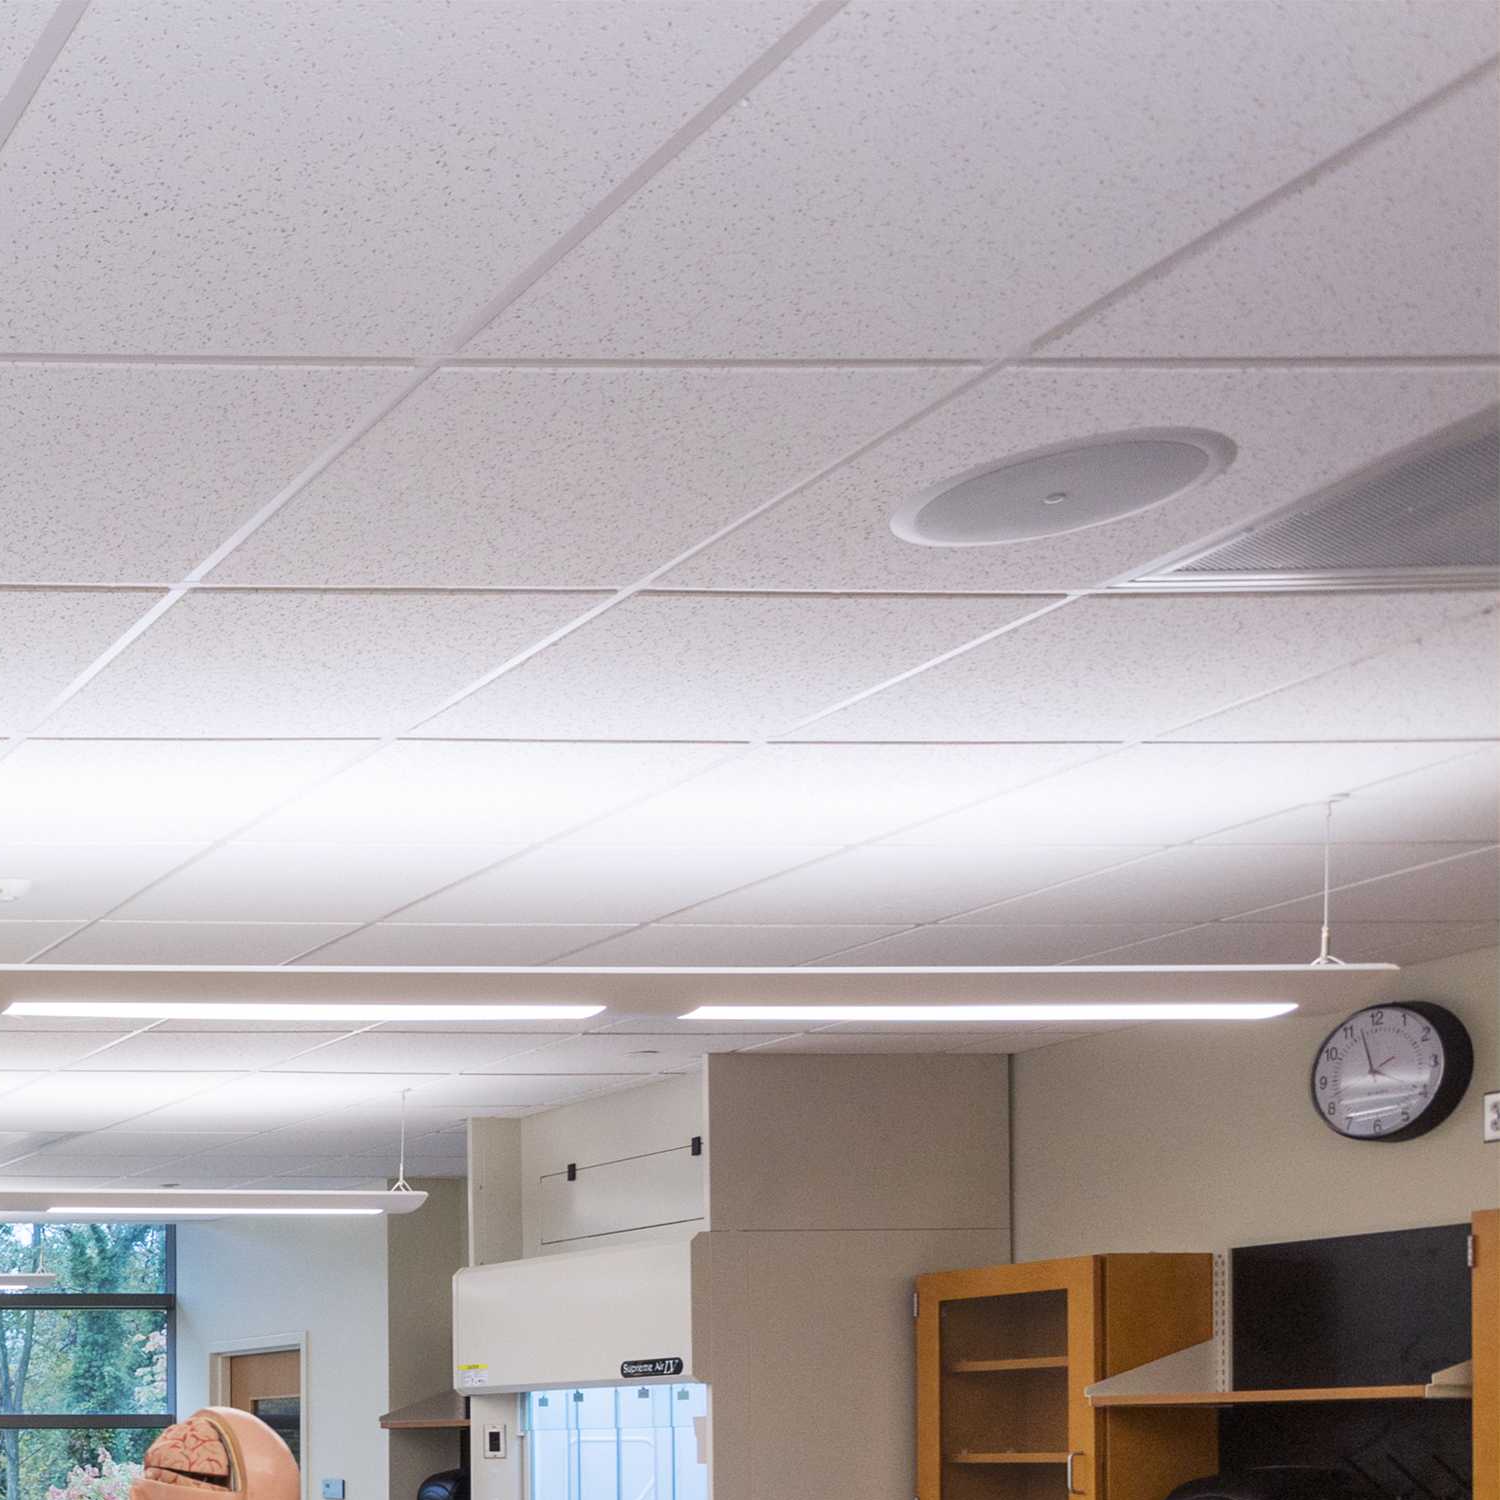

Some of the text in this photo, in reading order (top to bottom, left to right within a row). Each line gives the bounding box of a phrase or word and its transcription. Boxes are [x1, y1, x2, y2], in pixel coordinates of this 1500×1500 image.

[1369, 1010, 1384, 1026] 12
[1401, 1013, 1408, 1027] 1
[1343, 1026, 1355, 1040] 11
[1421, 1025, 1432, 1042] 2
[1325, 1047, 1338, 1061] 10
[1430, 1053, 1440, 1068] 3
[1319, 1076, 1328, 1090] 9
[1327, 1102, 1336, 1115] 8
[1401, 1107, 1410, 1122] 5
[1373, 1118, 1382, 1135] 6
